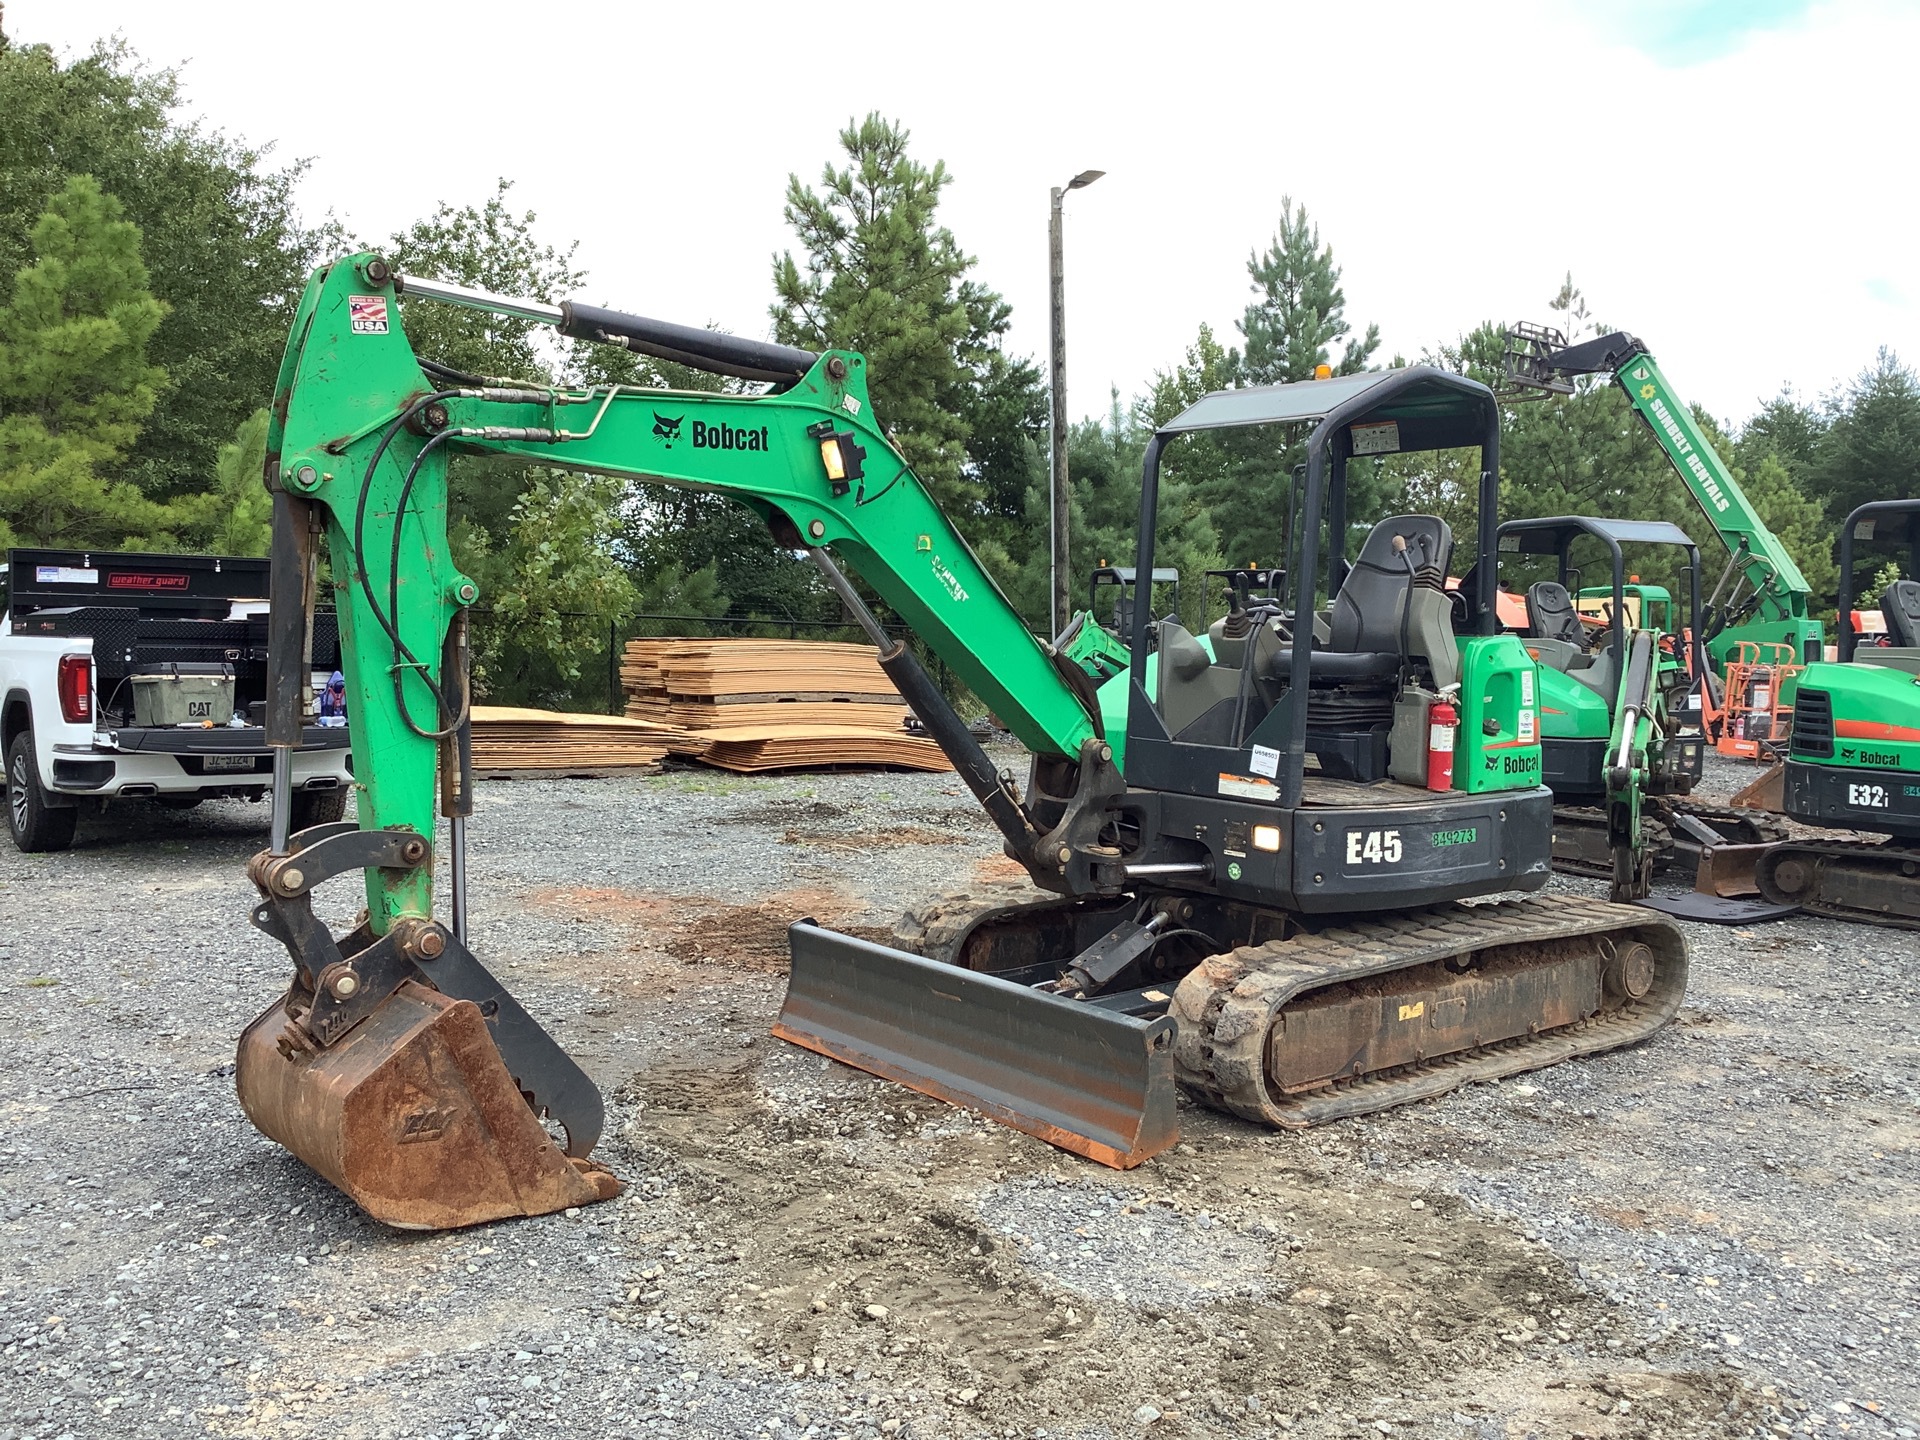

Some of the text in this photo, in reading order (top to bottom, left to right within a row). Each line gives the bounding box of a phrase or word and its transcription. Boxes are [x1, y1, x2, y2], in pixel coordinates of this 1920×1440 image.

[353, 321, 386, 331] USA
[692, 420, 769, 452] Bobcat
[1650, 398, 1730, 513] SUNBELT RENTALS
[111, 575, 153, 585] weather
[155, 576, 185, 587] guard
[189, 702, 212, 717] CAT
[1860, 751, 1901, 766] Bobcat
[1433, 830, 1474, 846] 849273
[1346, 830, 1403, 864] E45
